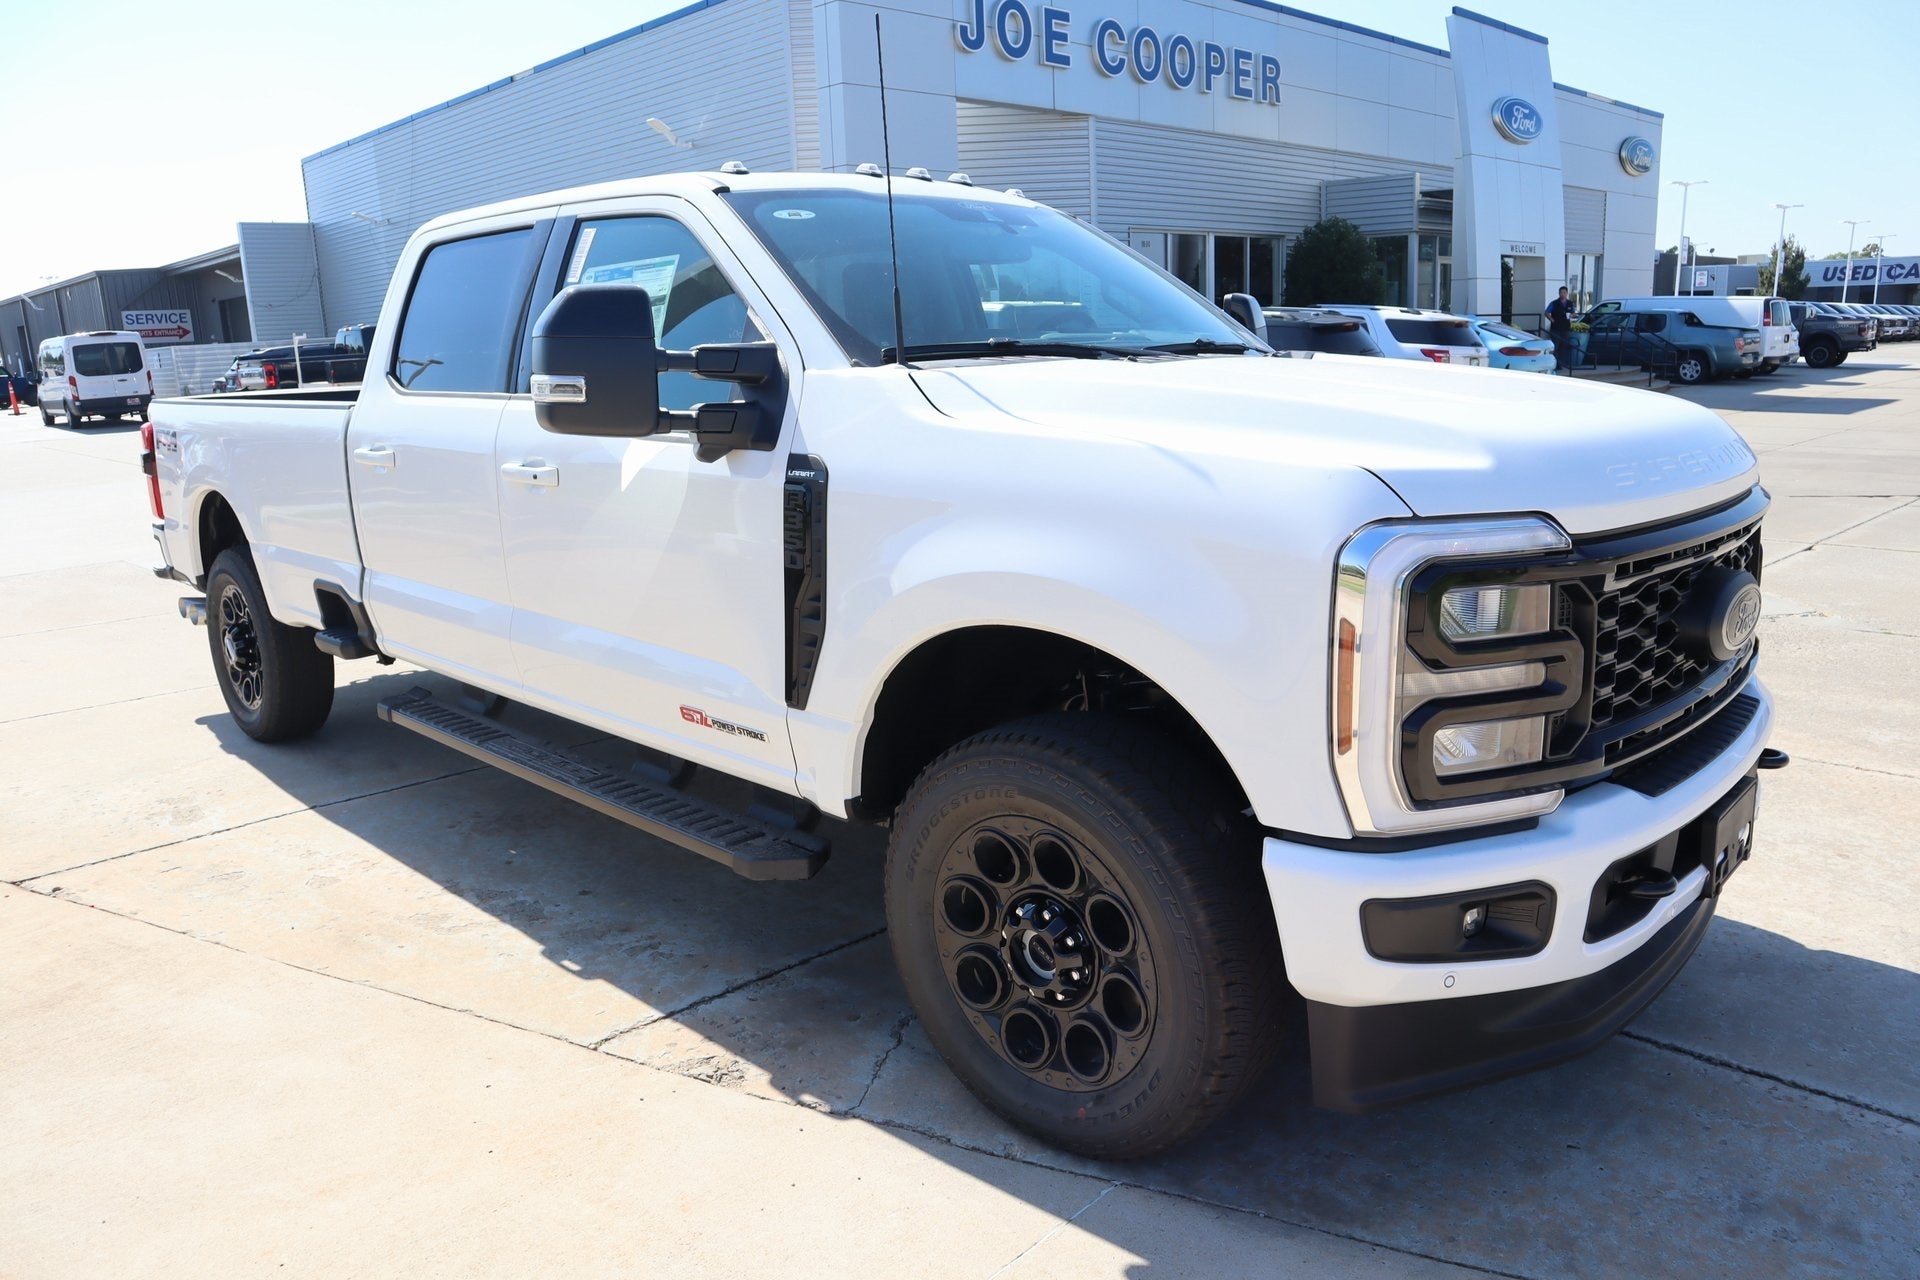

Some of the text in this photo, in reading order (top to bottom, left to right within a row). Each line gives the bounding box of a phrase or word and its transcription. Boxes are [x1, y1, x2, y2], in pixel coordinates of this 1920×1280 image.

[956, 0, 1281, 105] JOE COOPER
[1512, 105, 1537, 132] Ford
[1633, 145, 1653, 168] Ford
[1510, 244, 1537, 254] WELCOME
[1822, 264, 1879, 282] USED
[125, 312, 188, 326] SERVICE
[711, 718, 737, 734] POWER
[736, 726, 766, 743] STROKE
